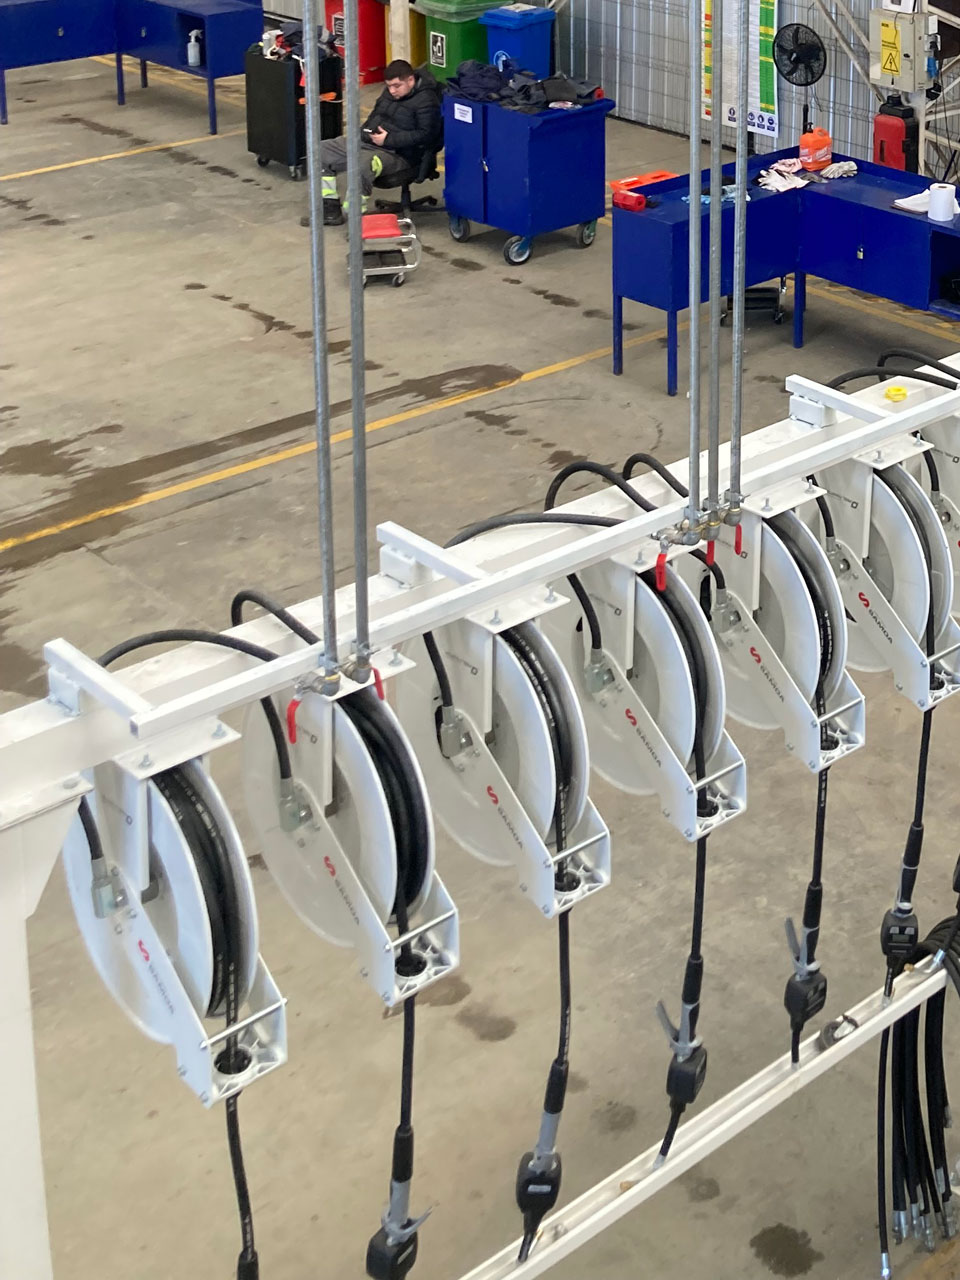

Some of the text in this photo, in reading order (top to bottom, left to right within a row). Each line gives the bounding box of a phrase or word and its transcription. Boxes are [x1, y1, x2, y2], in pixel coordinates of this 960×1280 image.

[868, 609, 893, 644] SAMOA
[760, 665, 784, 702] SAMOA
[636, 728, 661, 768] SAMOA
